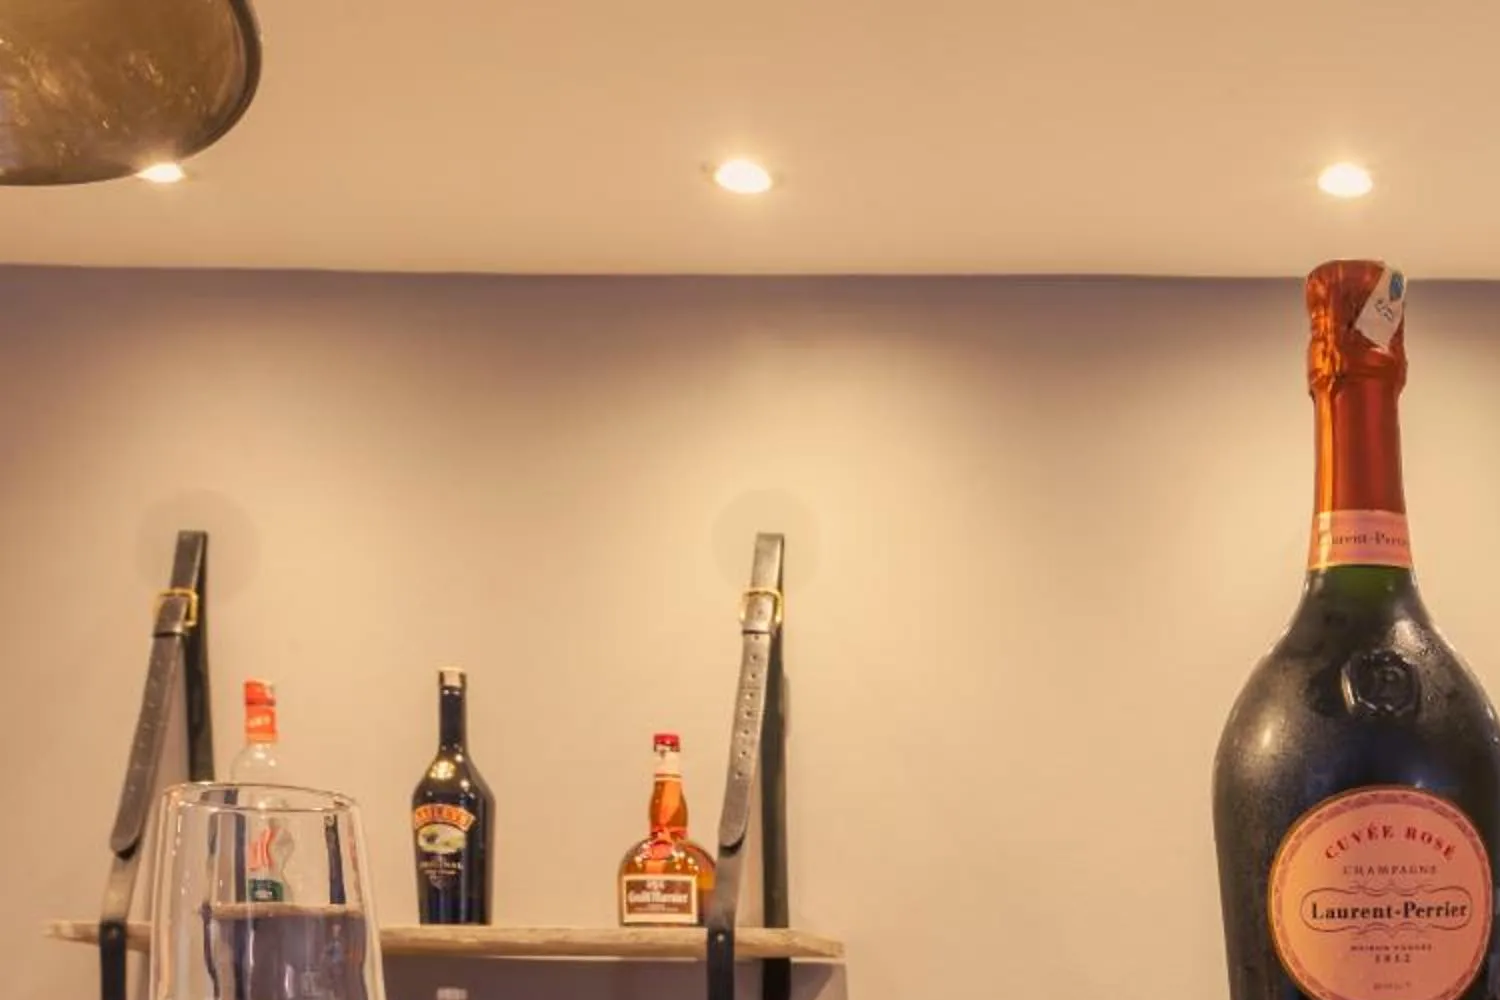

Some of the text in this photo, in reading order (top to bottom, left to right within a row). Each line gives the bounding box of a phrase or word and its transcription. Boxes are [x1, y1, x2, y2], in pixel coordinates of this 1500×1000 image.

[1324, 822, 1395, 860] CUVÉE
[1342, 864, 1437, 876] CHAMPAGNE
[1311, 900, 1468, 921] Laurent-Perrier
